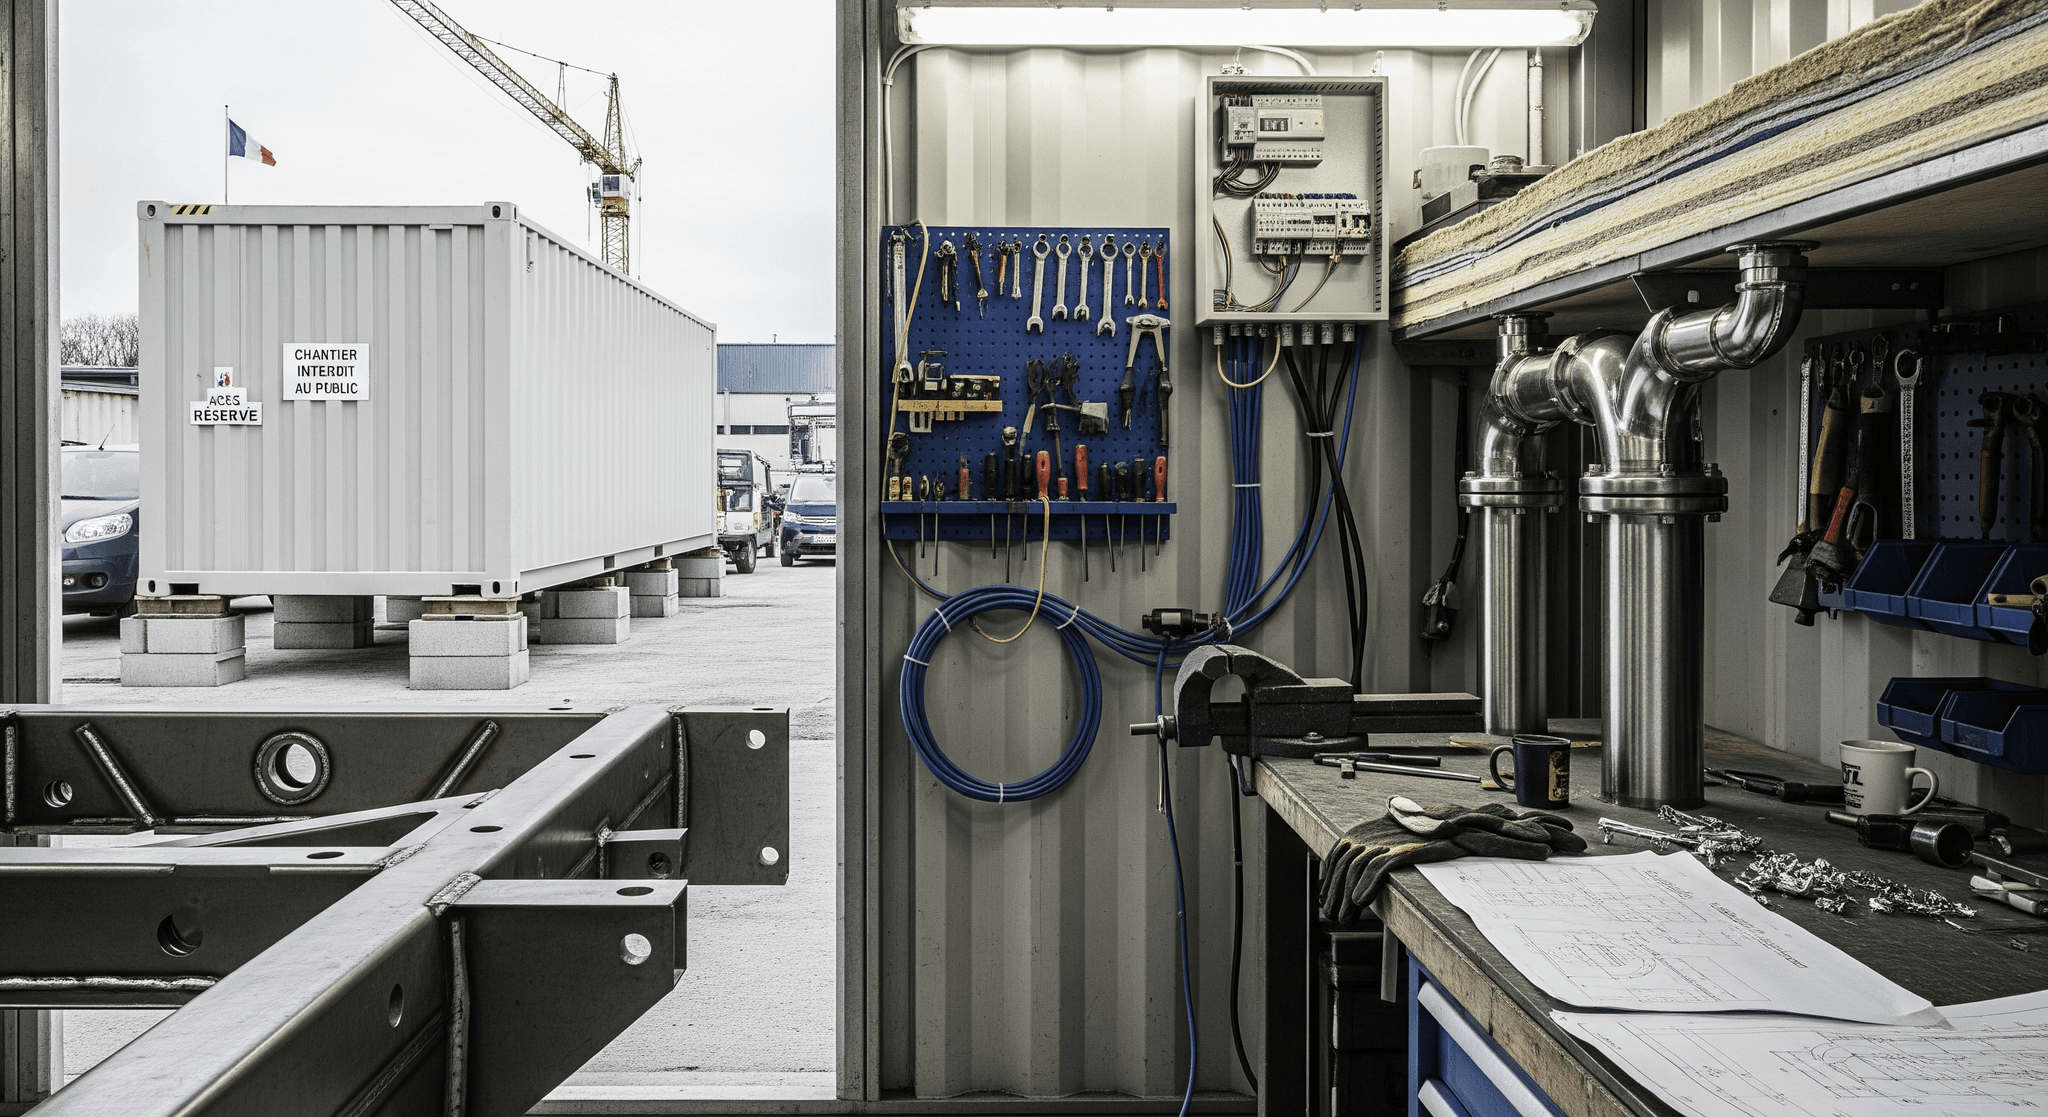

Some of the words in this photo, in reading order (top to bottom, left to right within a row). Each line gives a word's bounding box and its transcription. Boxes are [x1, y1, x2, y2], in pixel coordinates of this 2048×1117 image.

[294, 349, 358, 361] CHANTIER
[297, 365, 355, 377] INTERDIT
[294, 382, 312, 394] AU
[315, 382, 358, 394] PUBLIC
